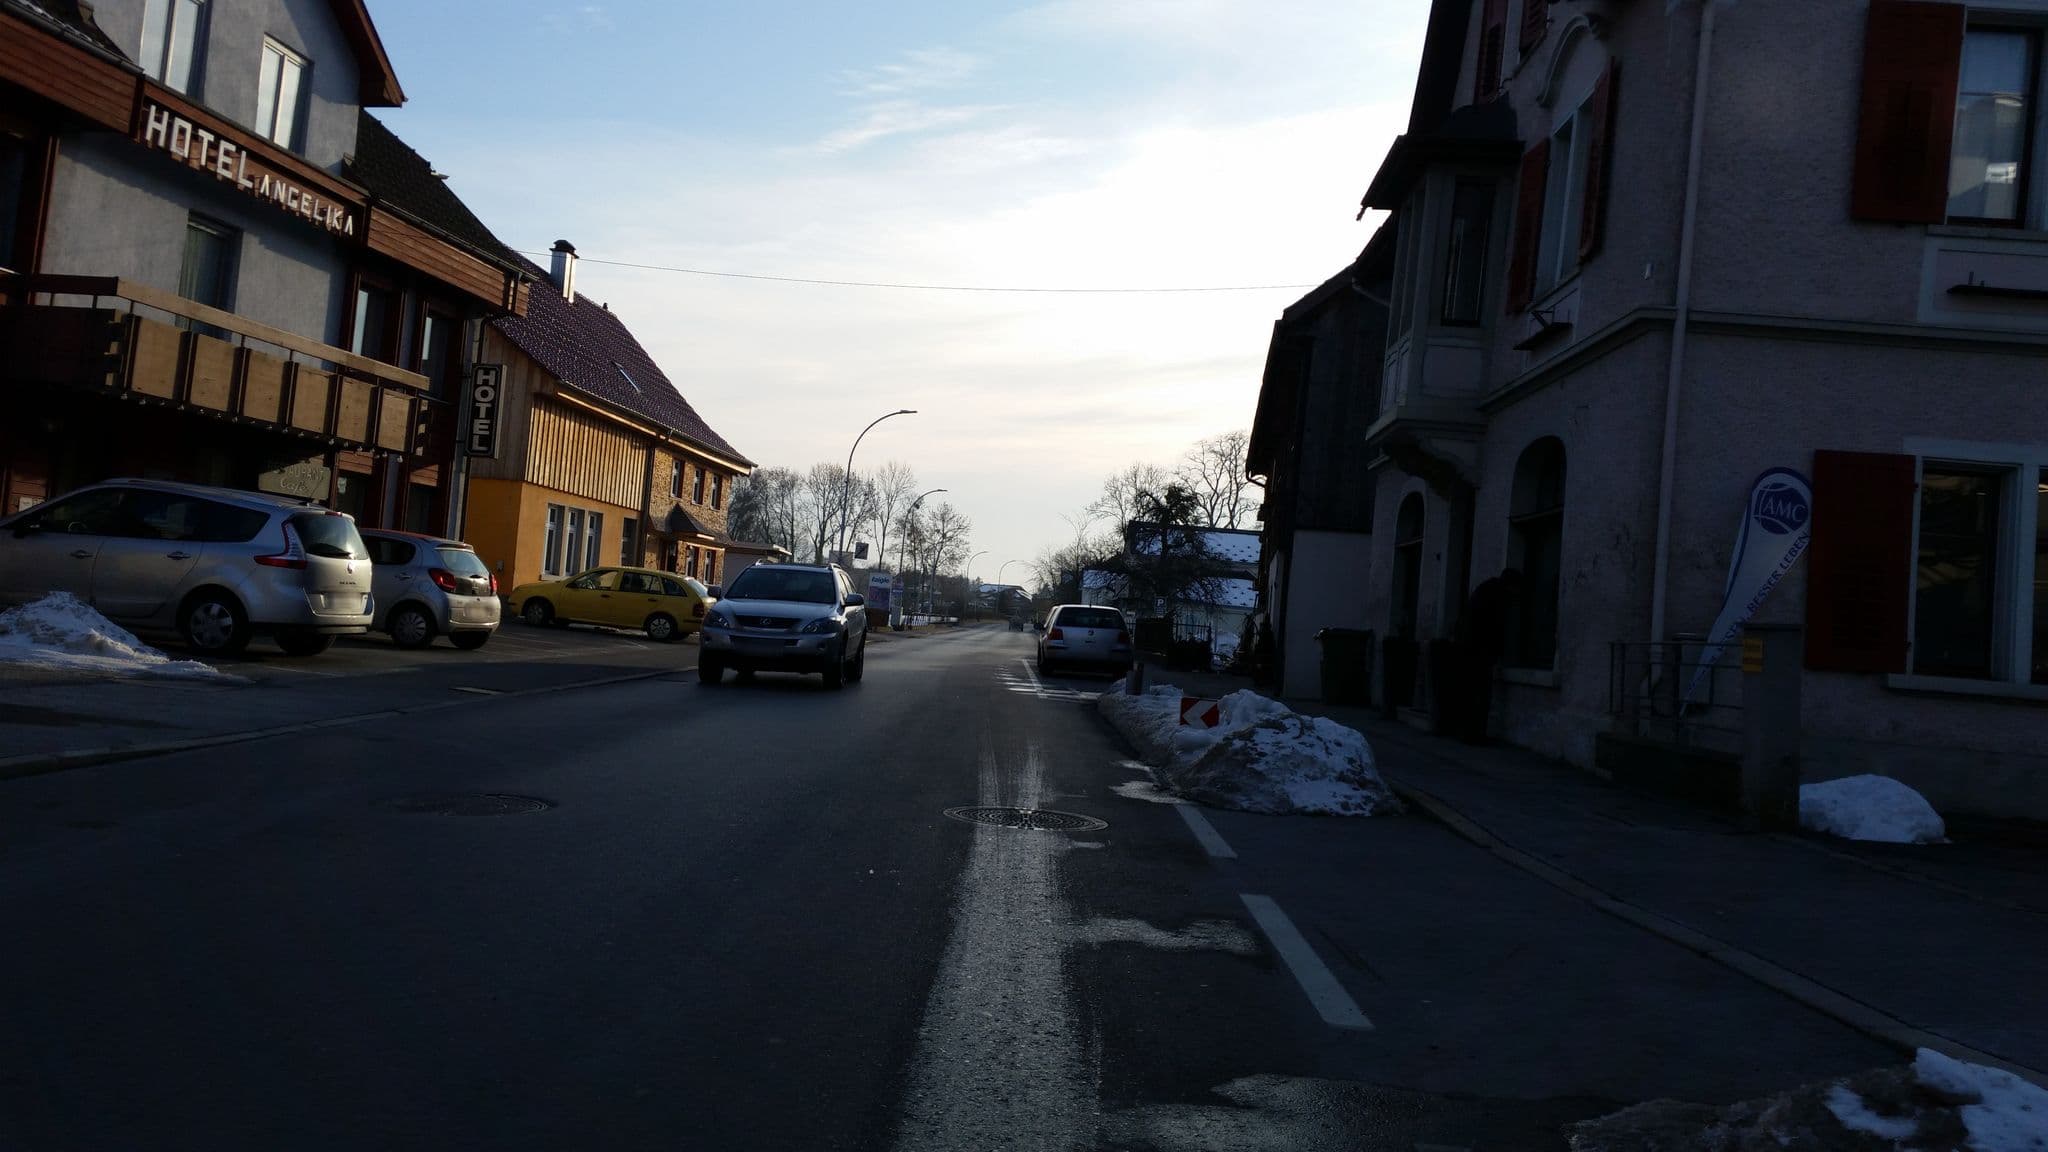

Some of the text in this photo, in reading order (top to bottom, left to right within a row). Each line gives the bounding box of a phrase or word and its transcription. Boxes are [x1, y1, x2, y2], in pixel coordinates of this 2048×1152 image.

[145, 104, 354, 236] HOTEL ANGELIKA
[472, 368, 496, 451] HOTEL
[1762, 494, 1808, 523] AMC
[1746, 570, 1783, 612] BESSER
[1779, 531, 1812, 570] LEBEN
